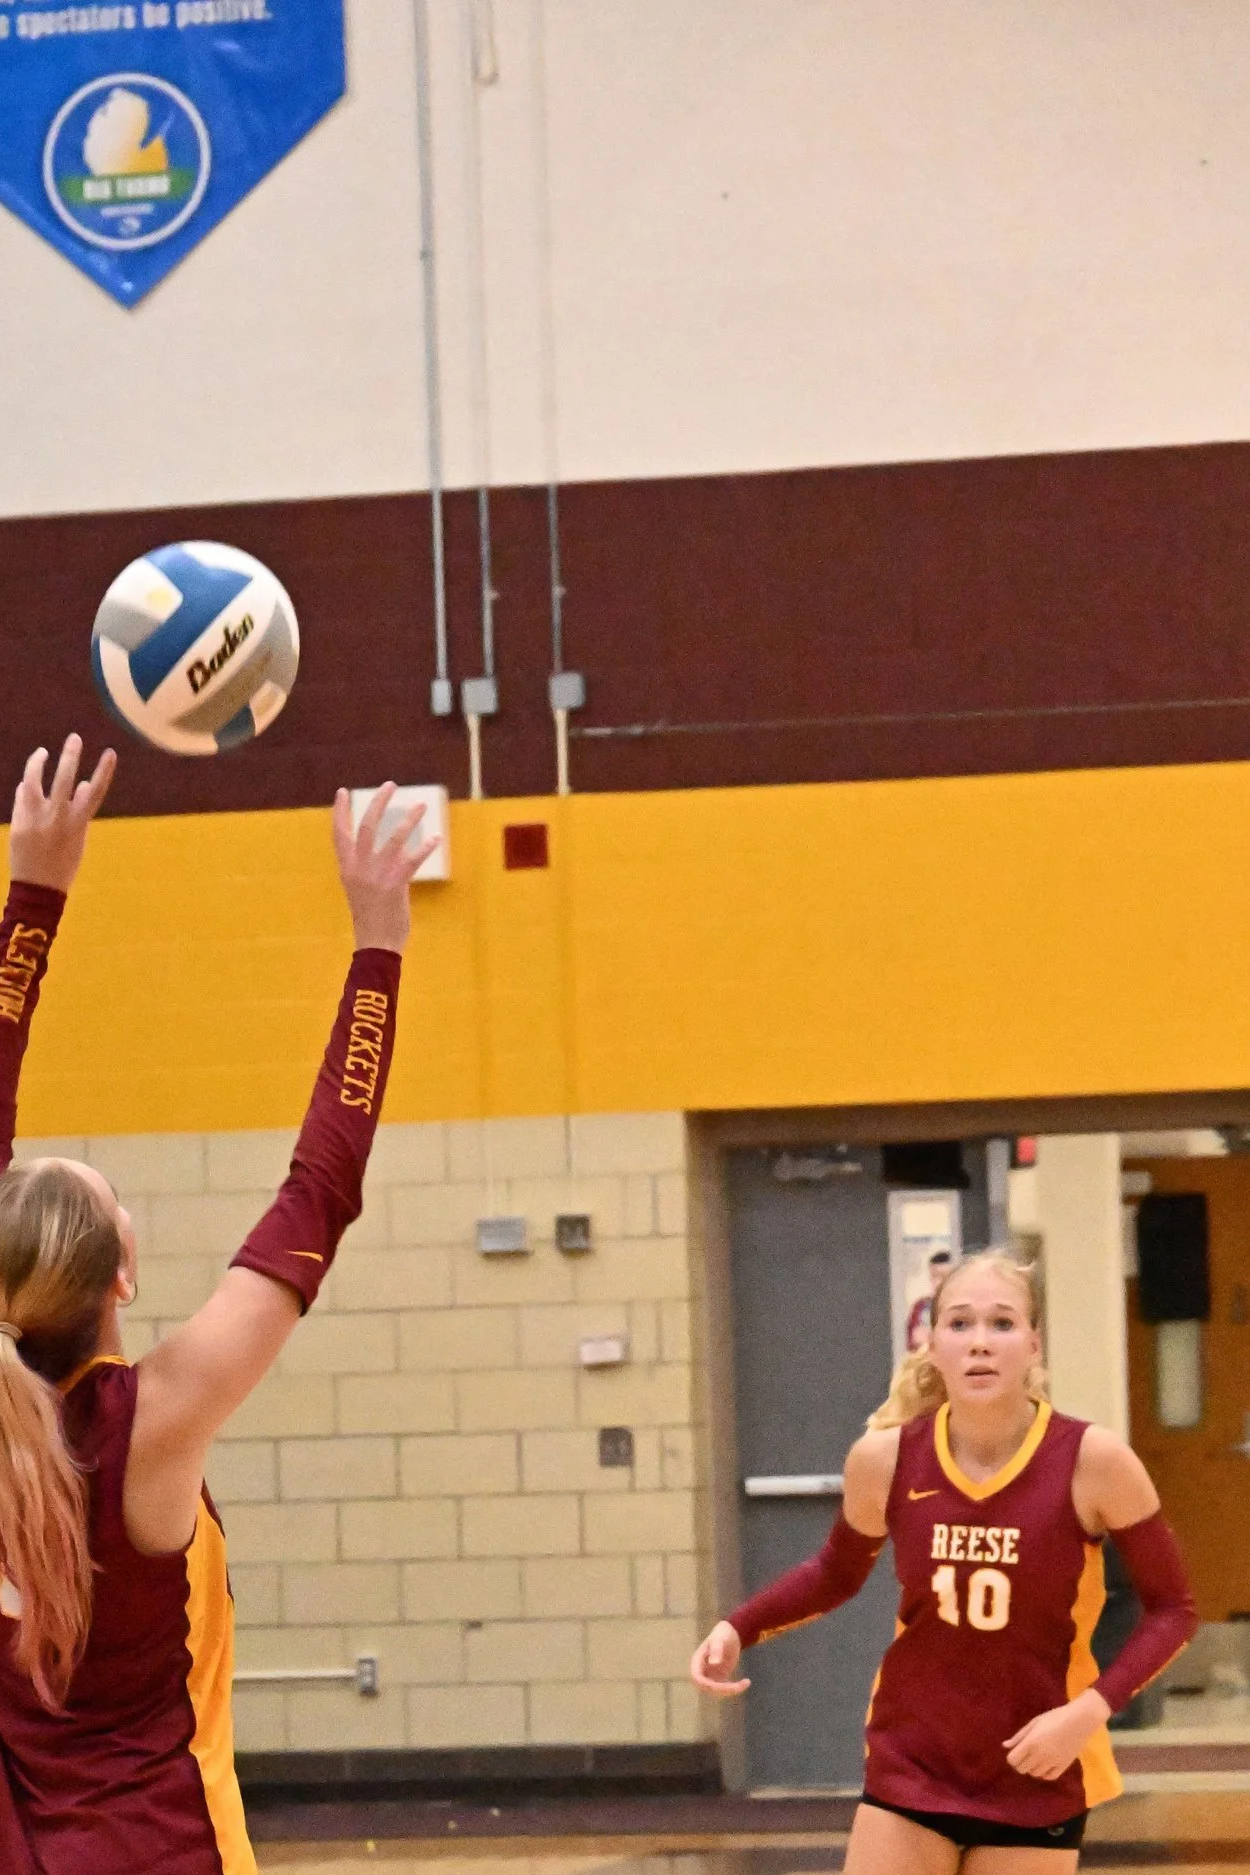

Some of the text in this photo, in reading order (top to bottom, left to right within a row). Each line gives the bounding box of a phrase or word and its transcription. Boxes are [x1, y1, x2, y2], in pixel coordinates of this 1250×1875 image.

[339, 988, 389, 1116] ROCKETS
[930, 1523, 1021, 1565] REESE
[931, 1564, 1012, 1632] 10
